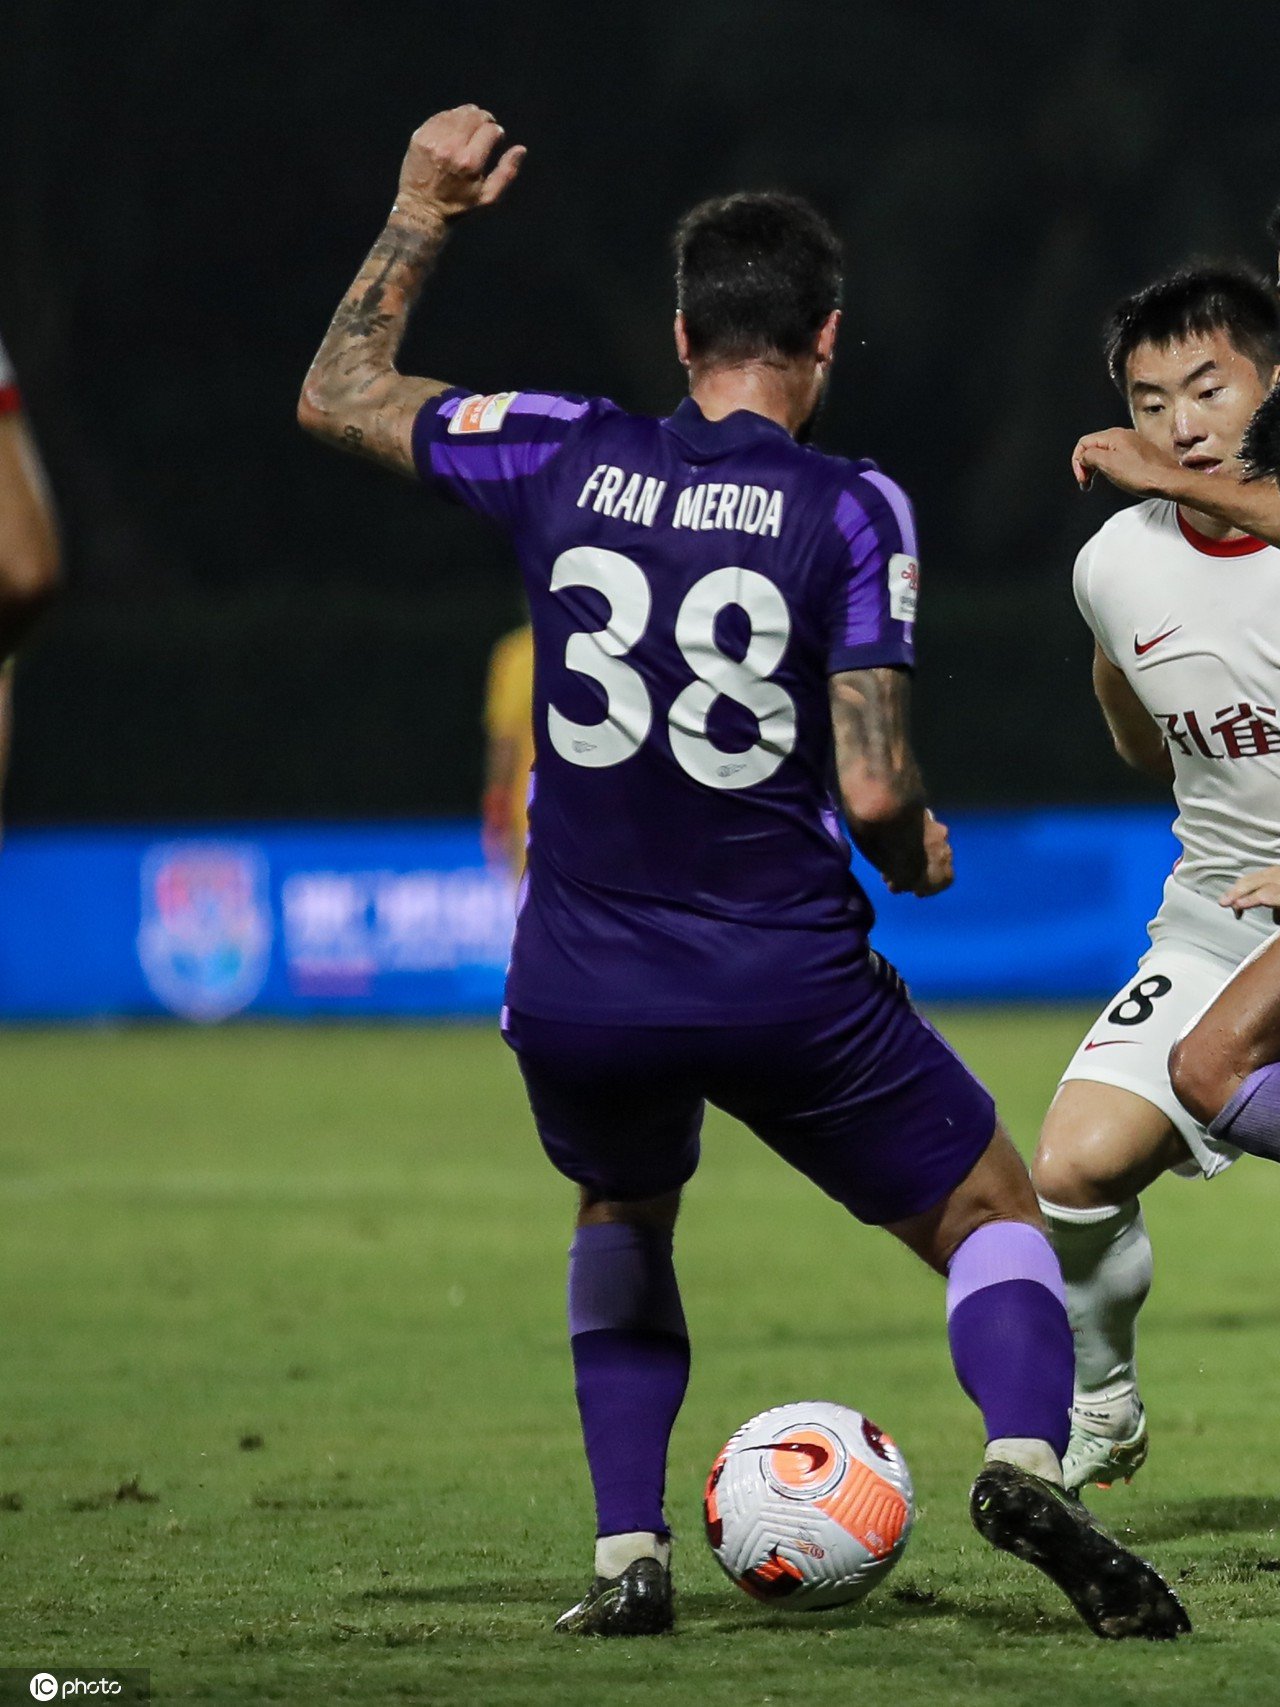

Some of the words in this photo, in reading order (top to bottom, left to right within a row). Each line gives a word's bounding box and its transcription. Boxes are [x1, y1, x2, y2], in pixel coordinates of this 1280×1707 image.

[577, 464, 667, 528] FRAN
[672, 483, 784, 538] MERIDA
[548, 545, 797, 789] 38
[1107, 974, 1172, 1026] 8
